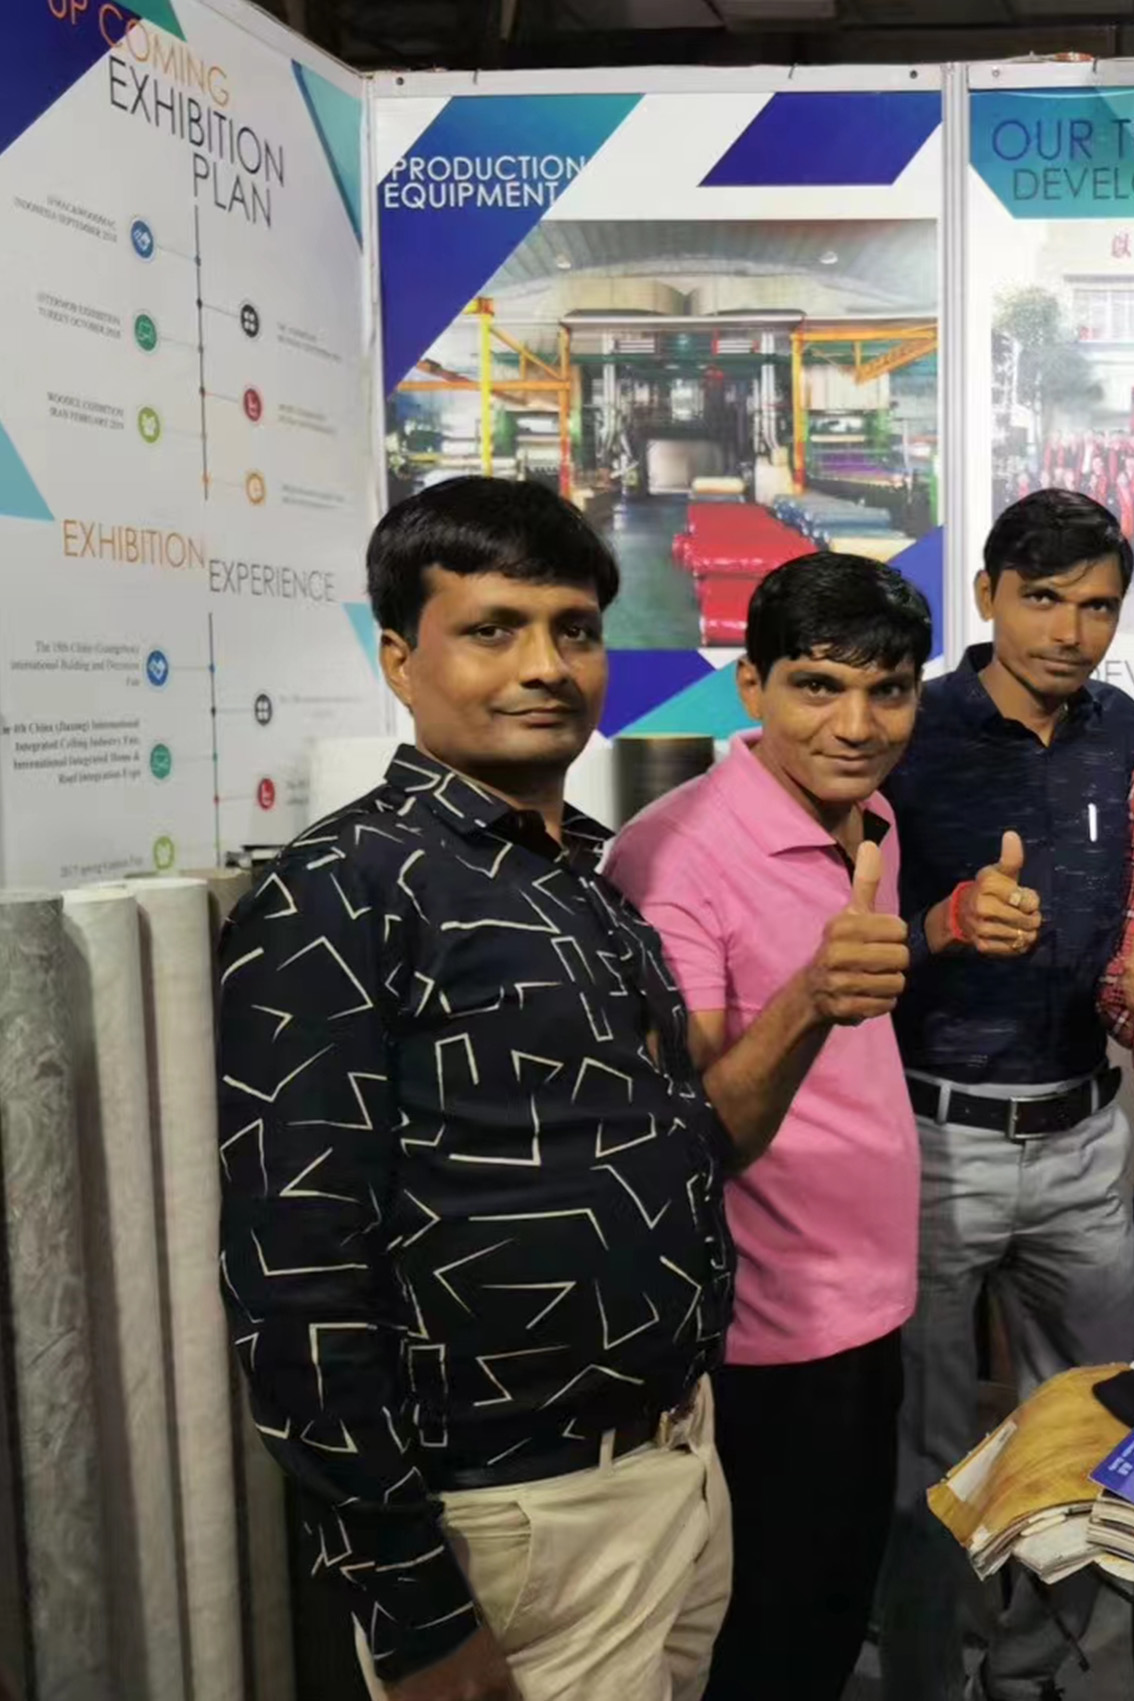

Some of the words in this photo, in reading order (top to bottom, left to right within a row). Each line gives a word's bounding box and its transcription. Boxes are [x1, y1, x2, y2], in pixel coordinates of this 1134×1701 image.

[99, 3, 229, 107] COMING
[109, 55, 284, 188] EXHIBITION
[992, 118, 1093, 162] OUR
[193, 152, 271, 229] PLAN
[391, 155, 589, 182] PRODUCTION
[384, 181, 560, 209] EQUIPMENT
[63, 519, 206, 569] EXHIBITION
[208, 559, 337, 603] EXPERIENCE
